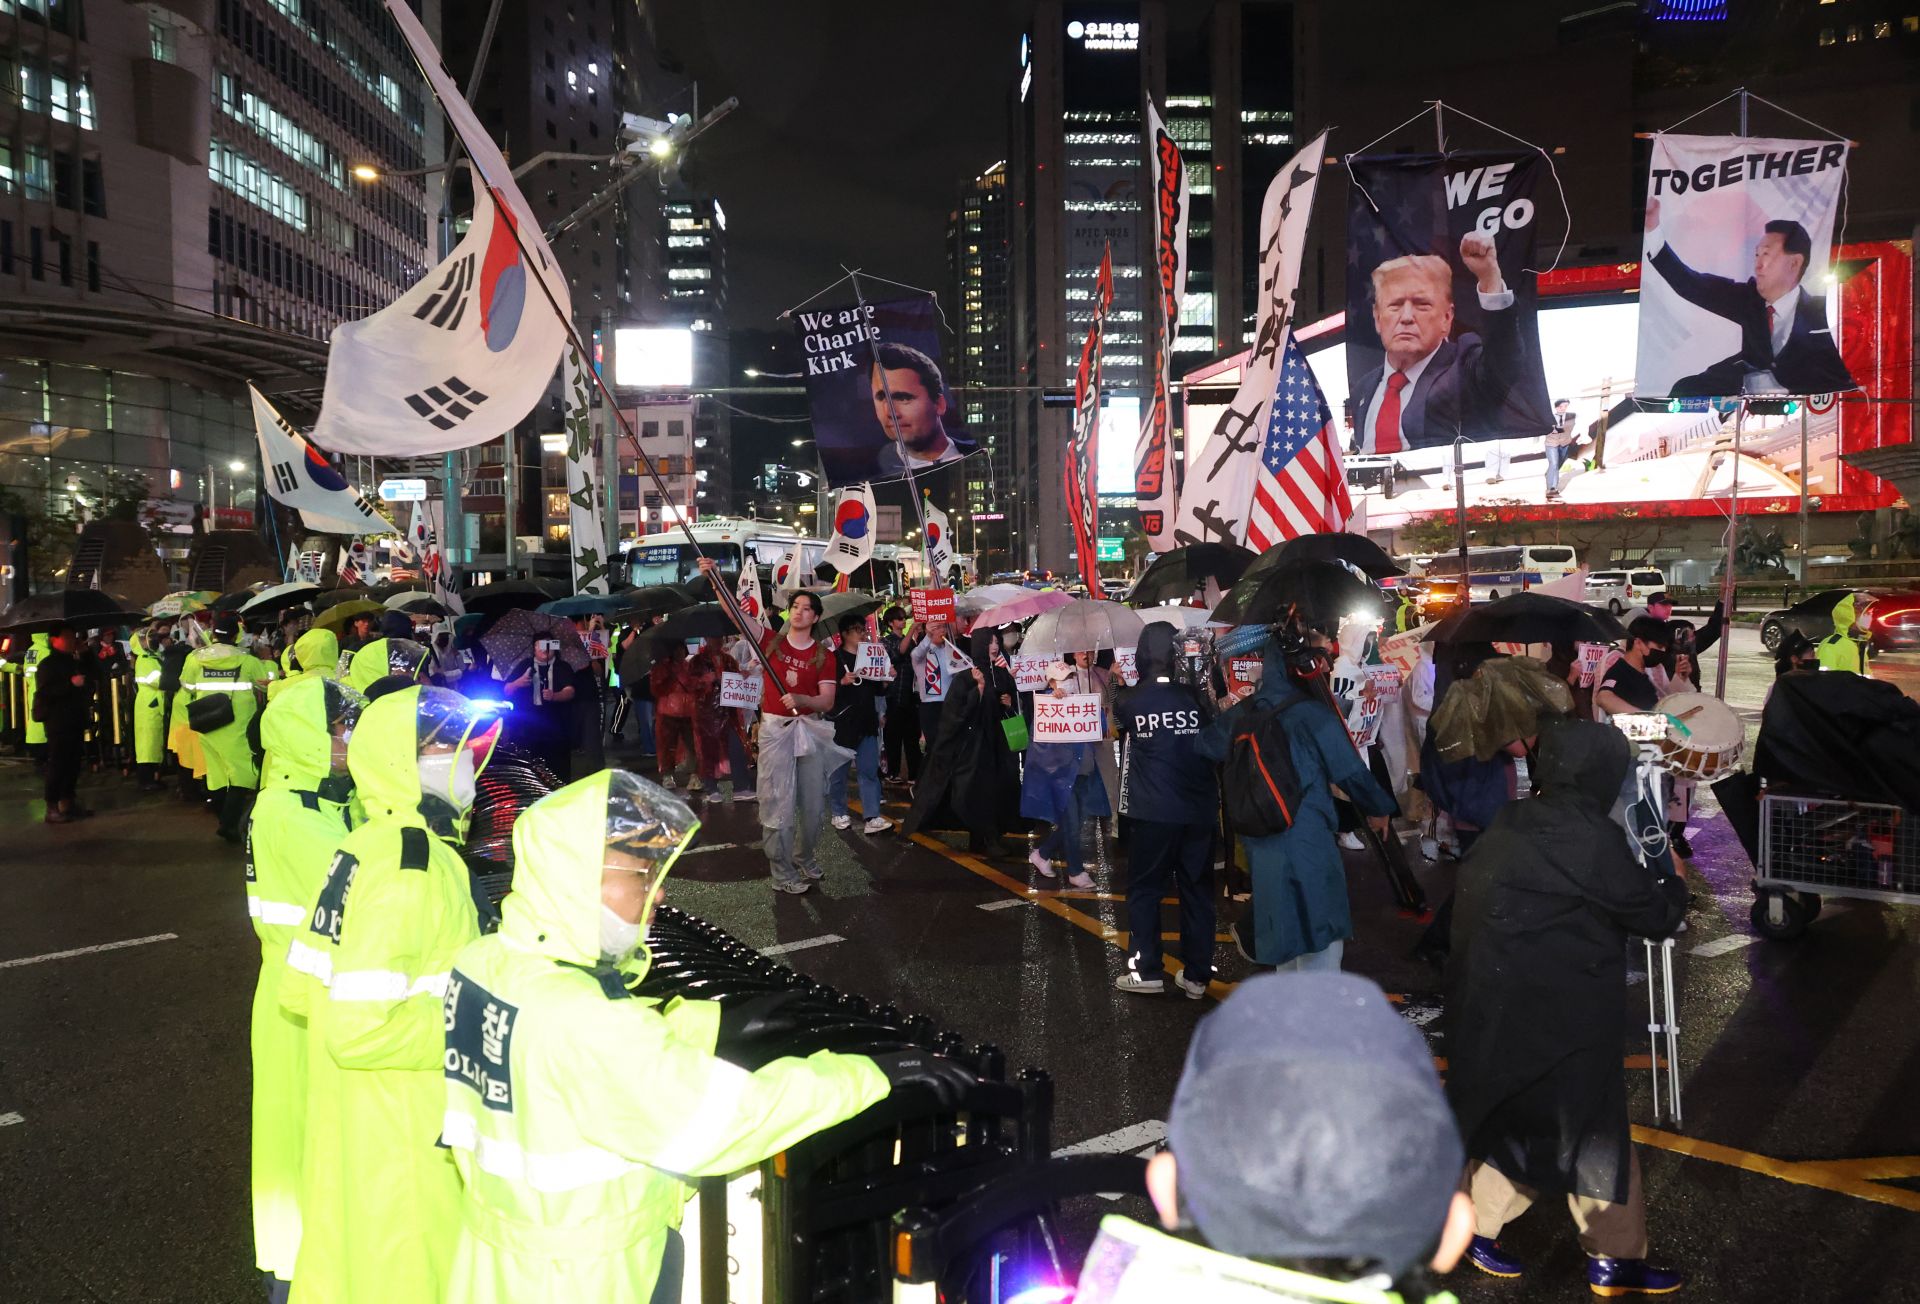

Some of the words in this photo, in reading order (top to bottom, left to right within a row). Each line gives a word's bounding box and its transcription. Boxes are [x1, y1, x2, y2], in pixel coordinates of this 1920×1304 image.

[1084, 22, 1139, 38] 우리은행
[1652, 143, 1845, 196] TOGETHER
[1445, 162, 1515, 210] WE
[1476, 198, 1535, 239] GO
[799, 312, 833, 331] We
[839, 305, 875, 325] are
[804, 322, 880, 353] Charlie
[807, 351, 857, 375] Kirk
[1813, 393, 1830, 405] 50
[870, 657, 884, 666] THE
[1586, 649, 1603, 660] STOP
[724, 678, 758, 693] 天灭中共
[1374, 686, 1388, 695] HINA
[723, 691, 745, 701] CHINA
[746, 694, 757, 703] OUT
[1037, 702, 1097, 719] 天灭中共
[1037, 722, 1071, 733] CHINA
[1073, 721, 1099, 732] OUT
[1135, 711, 1199, 731] PRESS
